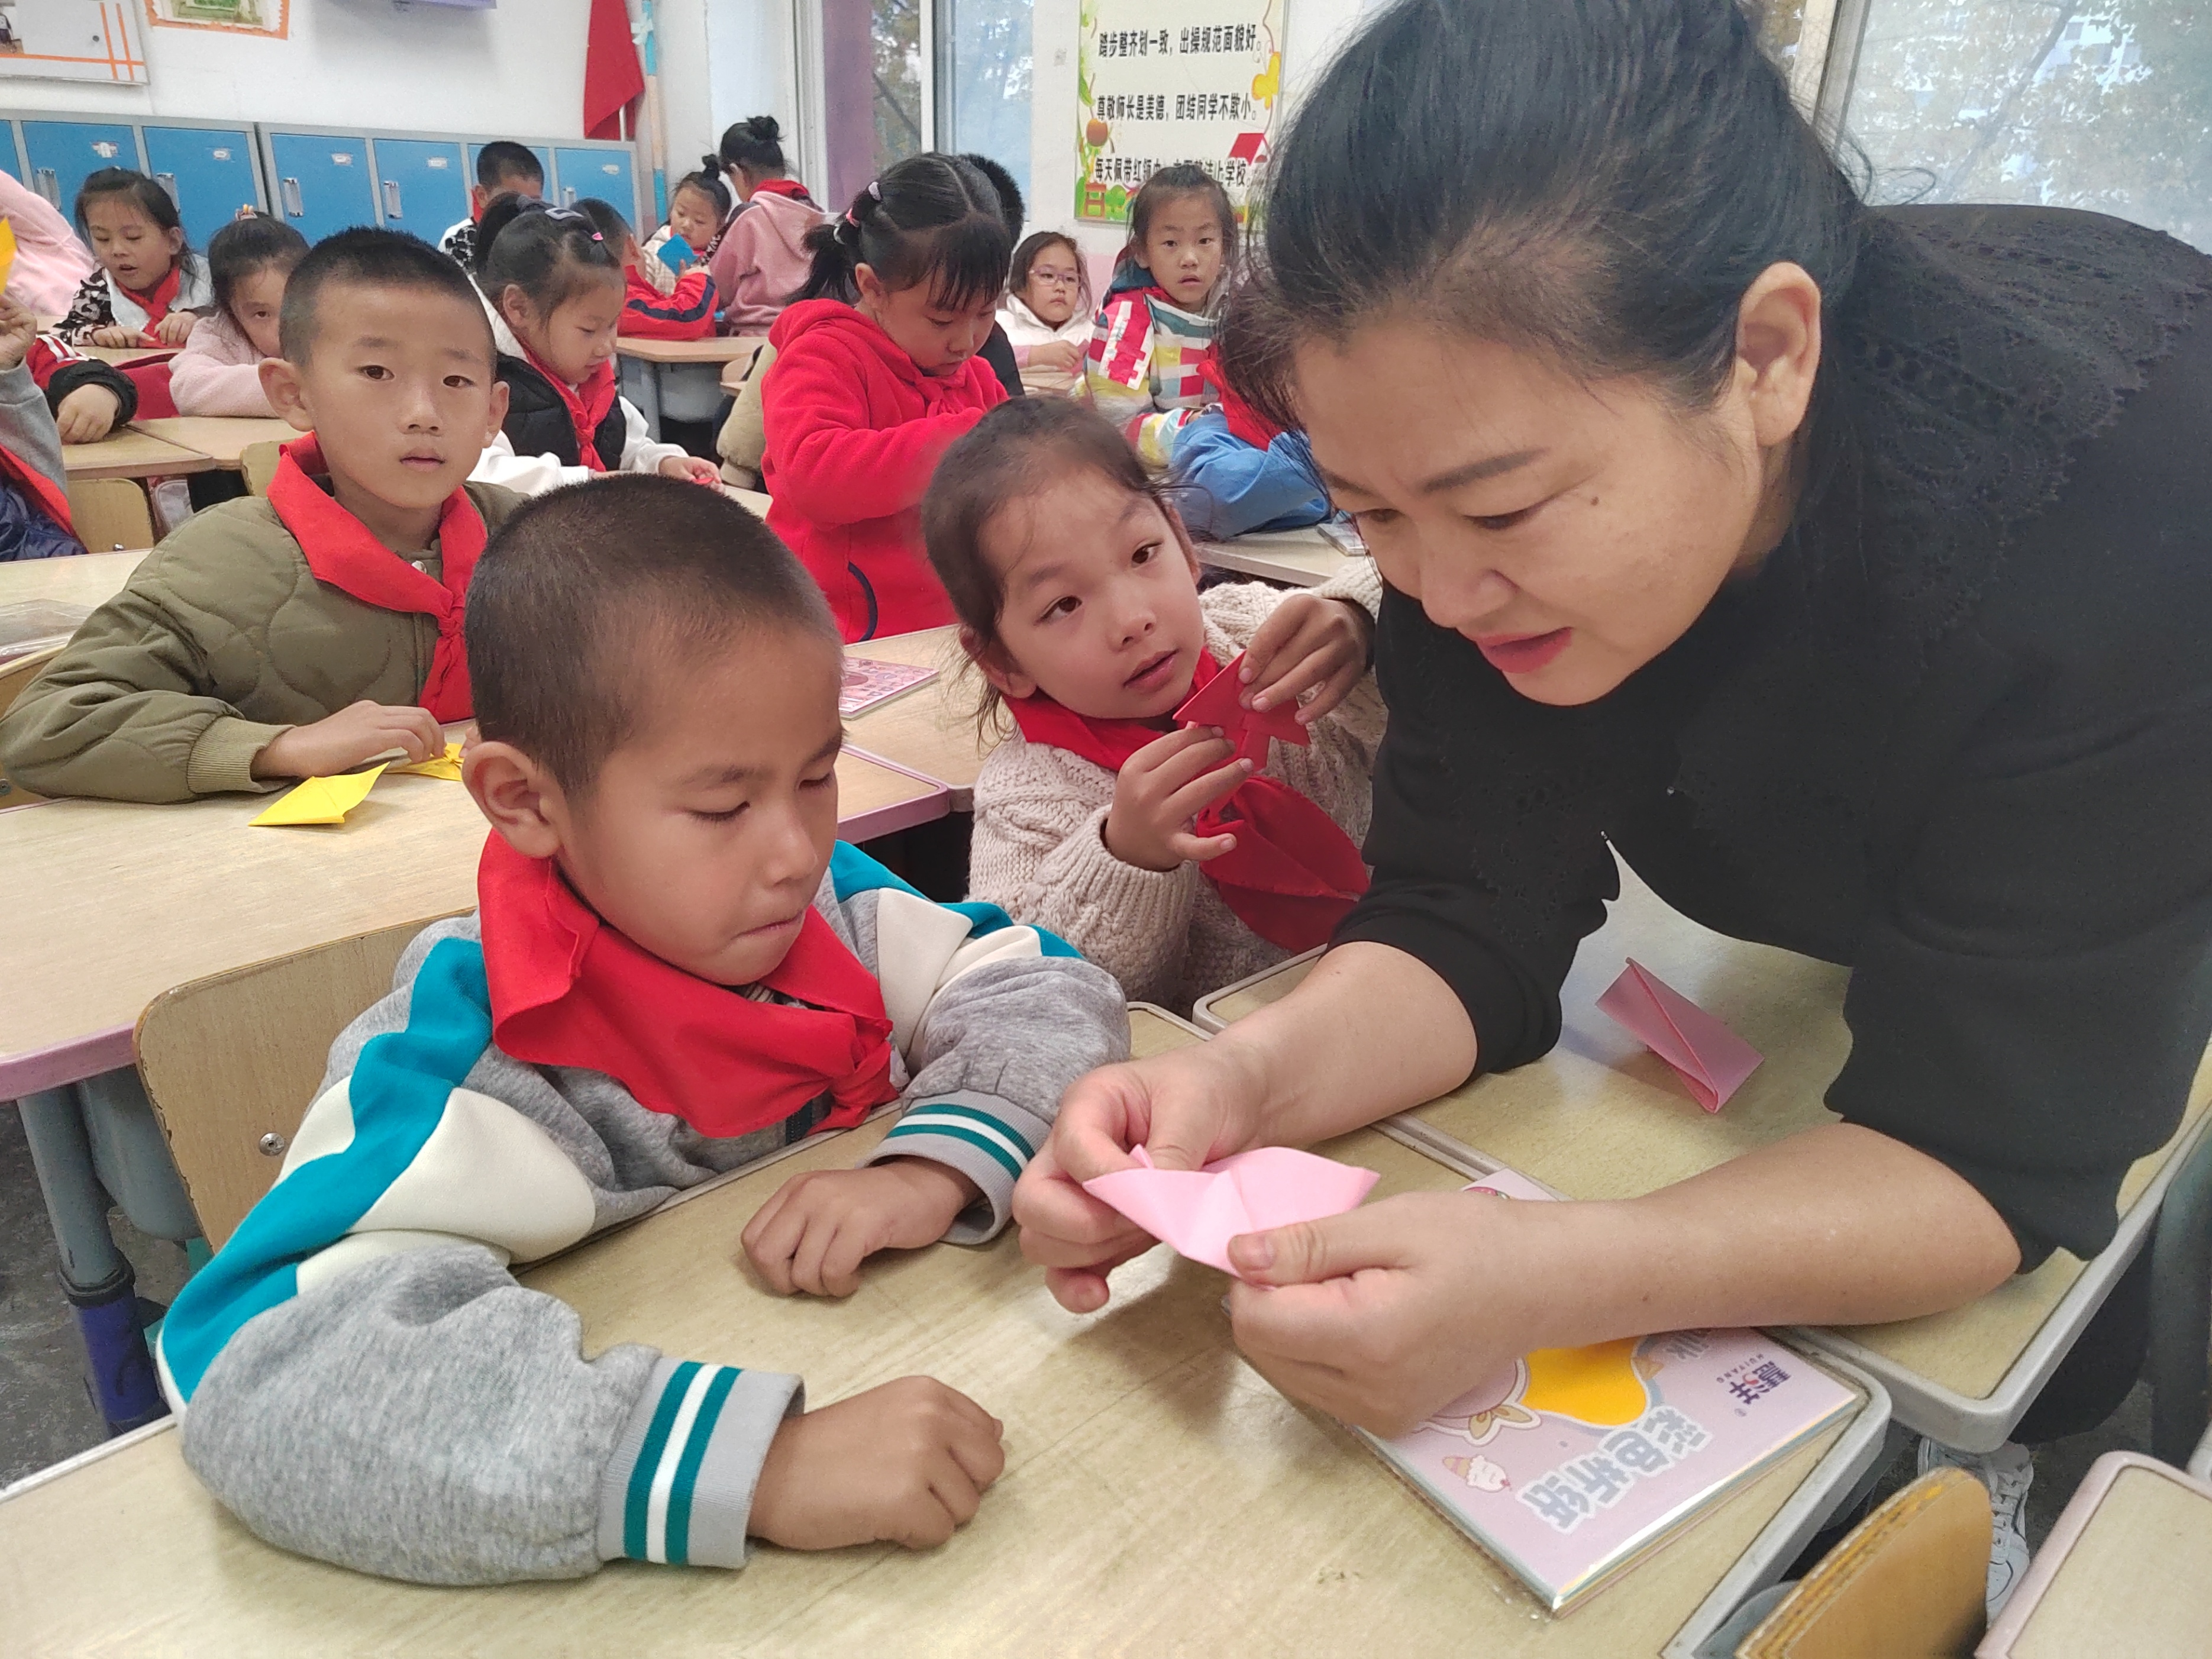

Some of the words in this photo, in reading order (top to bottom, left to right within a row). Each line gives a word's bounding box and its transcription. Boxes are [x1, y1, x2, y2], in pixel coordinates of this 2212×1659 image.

[1716, 1353, 1764, 1383] HUIYANG
[1729, 1361, 1791, 1405] 慧洋
[1520, 1409, 1707, 1531] 彩色折纸
